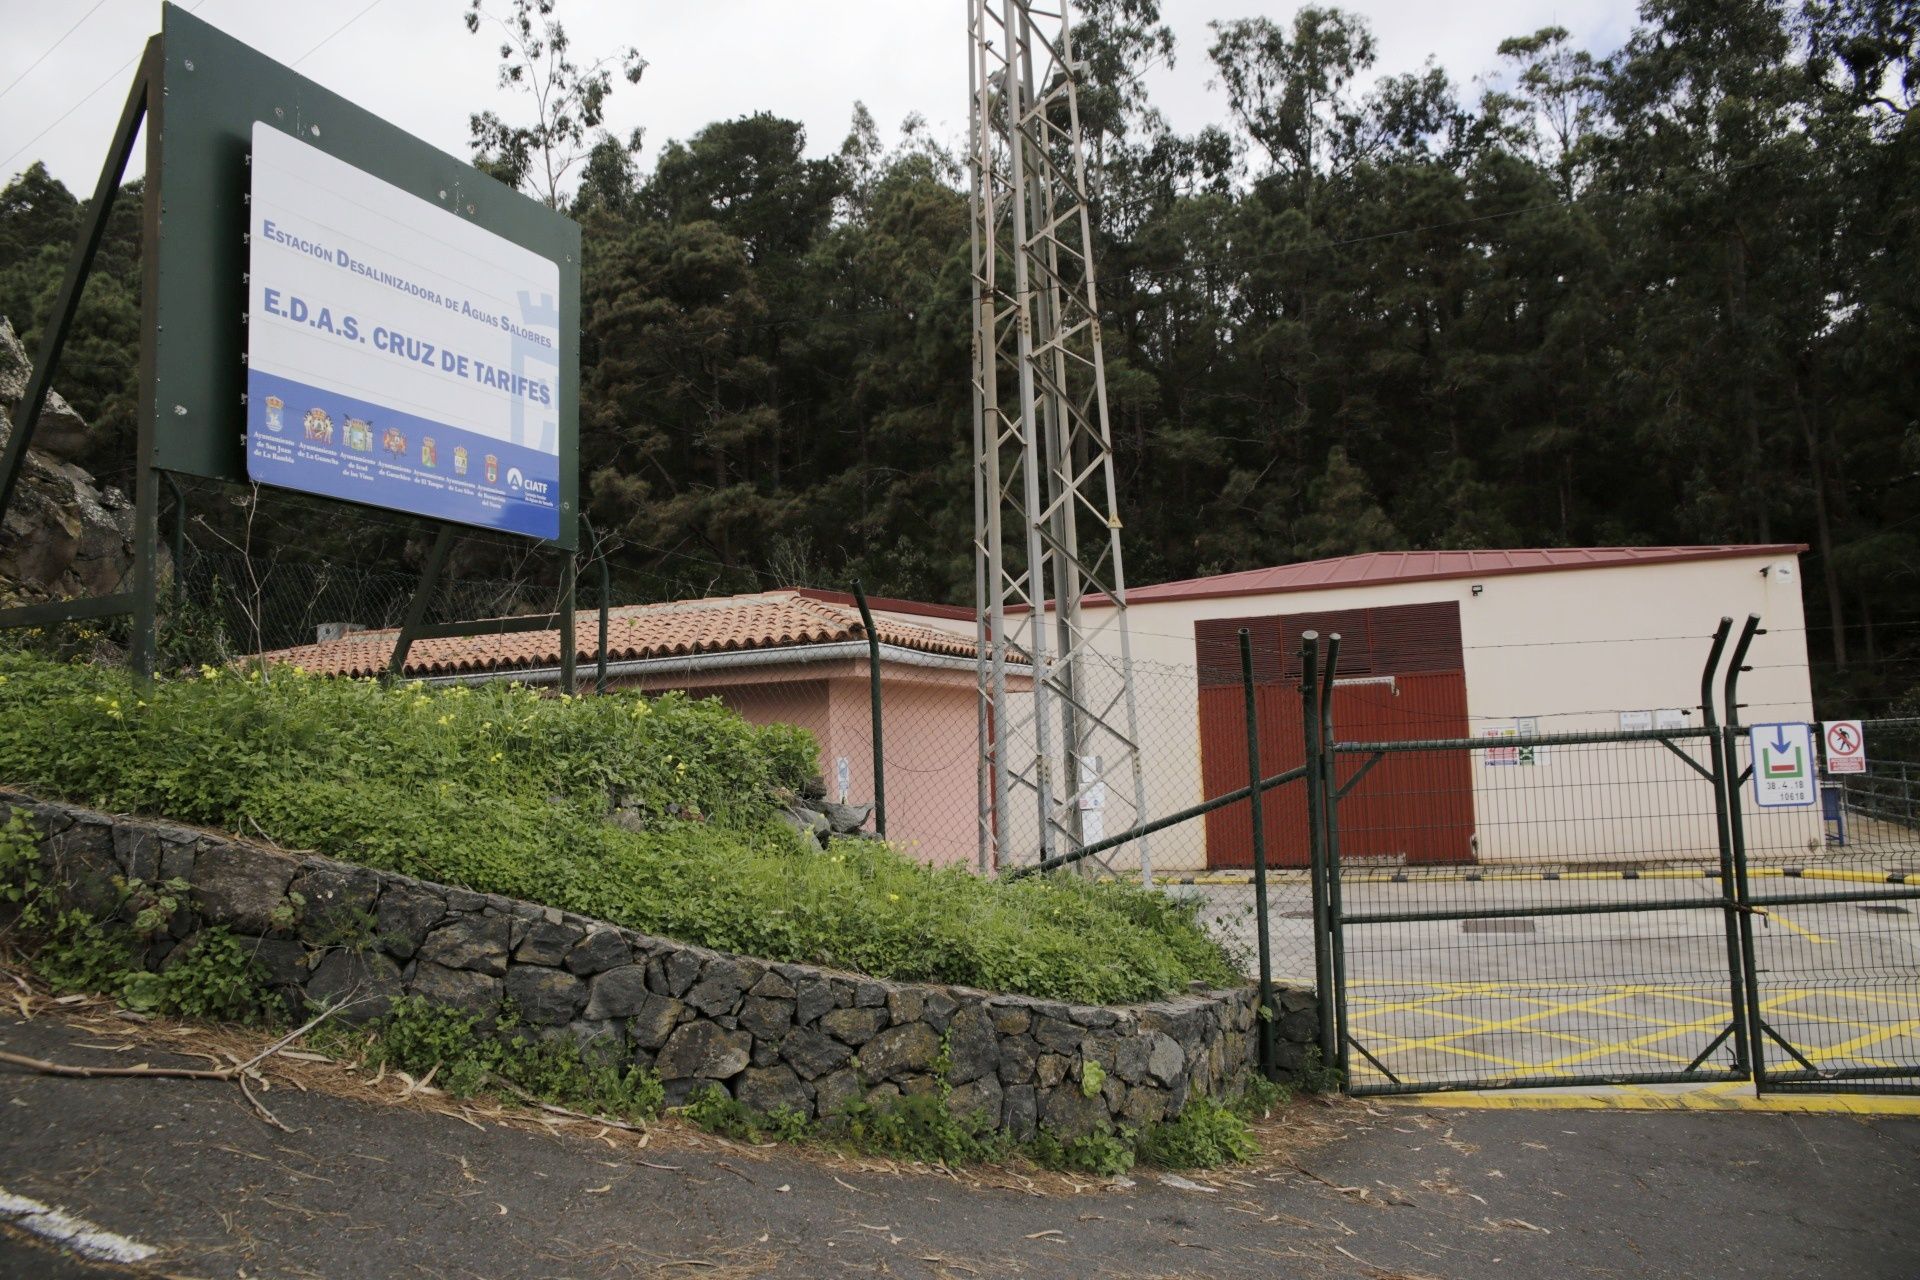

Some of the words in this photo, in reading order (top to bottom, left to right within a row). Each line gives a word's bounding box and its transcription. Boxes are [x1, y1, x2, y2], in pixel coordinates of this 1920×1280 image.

[263, 287, 365, 344] E.D.A.S.
[373, 326, 435, 367] CRUZ
[441, 349, 469, 379] DE
[474, 360, 551, 404] TARIFES
[254, 431, 294, 446] Ayuntamiento
[300, 442, 338, 456] Ayuntamiento
[524, 479, 547, 494] CIATF
